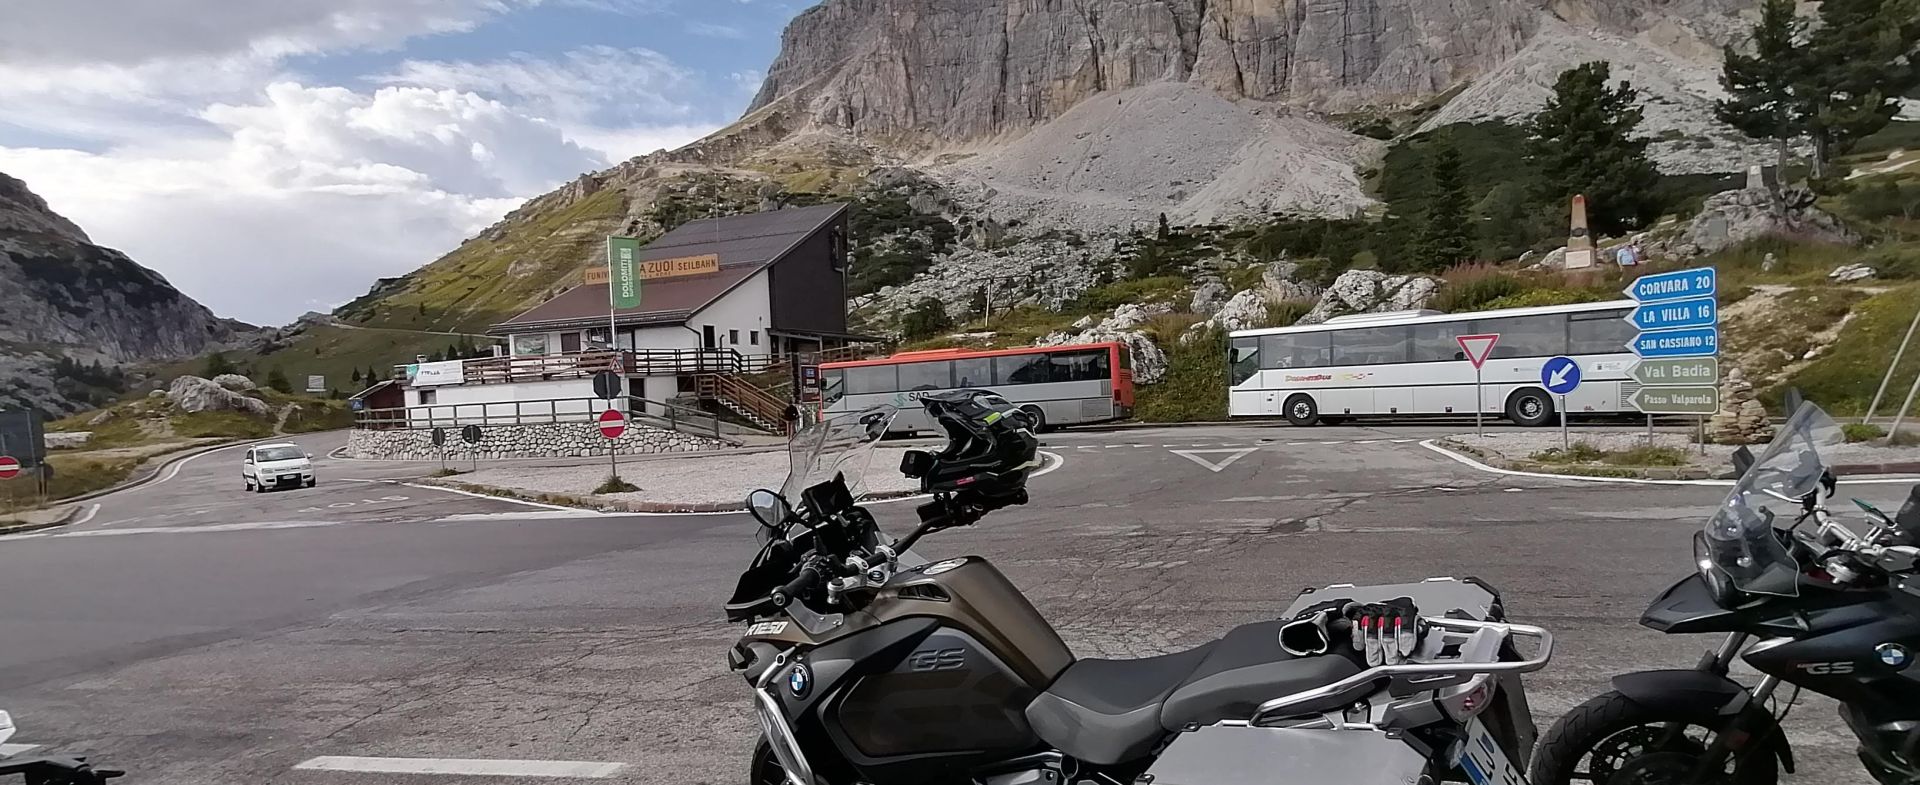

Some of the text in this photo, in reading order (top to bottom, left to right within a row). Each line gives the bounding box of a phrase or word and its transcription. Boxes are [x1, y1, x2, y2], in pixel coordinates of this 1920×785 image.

[587, 258, 717, 281] FUNIV AZUOI SEILBAHN
[1640, 275, 1710, 296] CORVARA 20
[1643, 304, 1710, 323] LA VILLA 16
[1640, 335, 1715, 350] SAN CASSIANO 12
[1644, 364, 1711, 378] Val Badia
[1644, 393, 1712, 406] Passo Valparola
[744, 621, 789, 637] R1250
[909, 648, 966, 671] GS
[1797, 661, 1855, 675] GS
